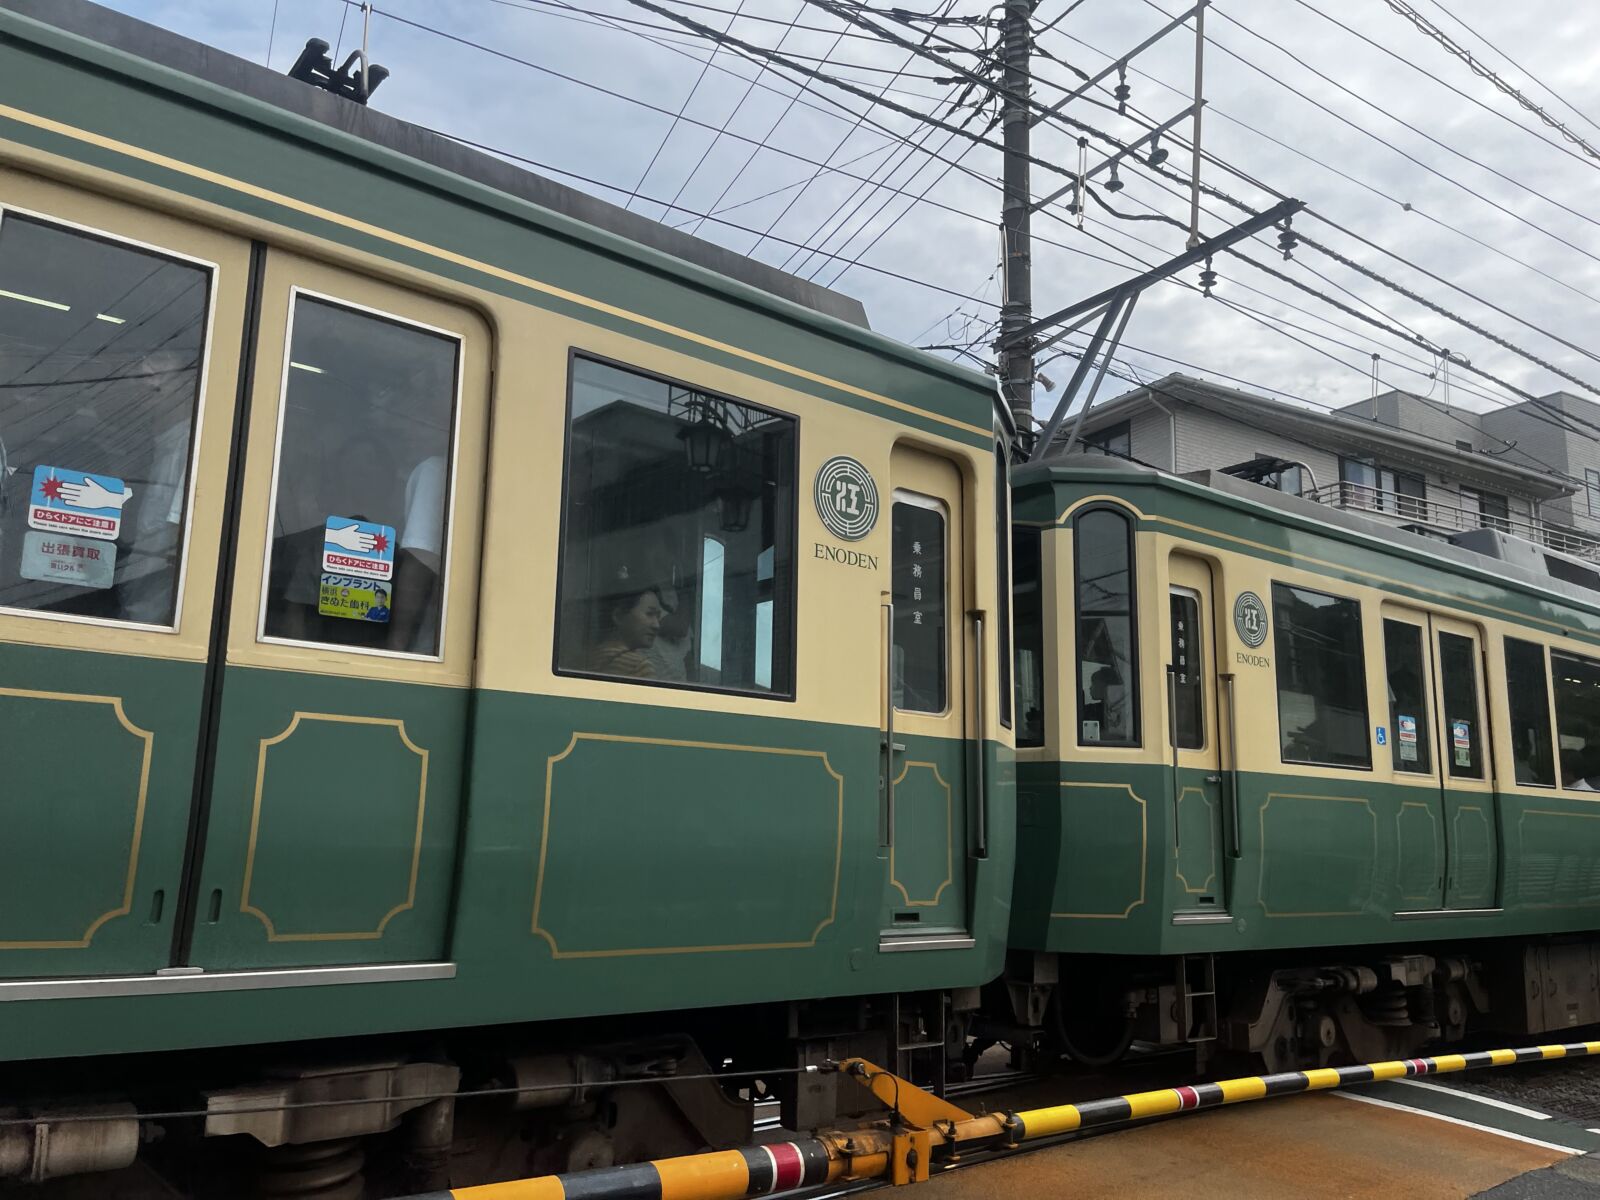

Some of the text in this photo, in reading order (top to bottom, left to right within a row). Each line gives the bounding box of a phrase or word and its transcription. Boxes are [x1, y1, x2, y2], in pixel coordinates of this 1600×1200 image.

[41, 541, 100, 560] 出張買取
[814, 542, 878, 570] ENODEN
[322, 575, 381, 591] インプラント
[320, 596, 369, 610] きぬた歯科
[1236, 652, 1270, 668] ENODEN
